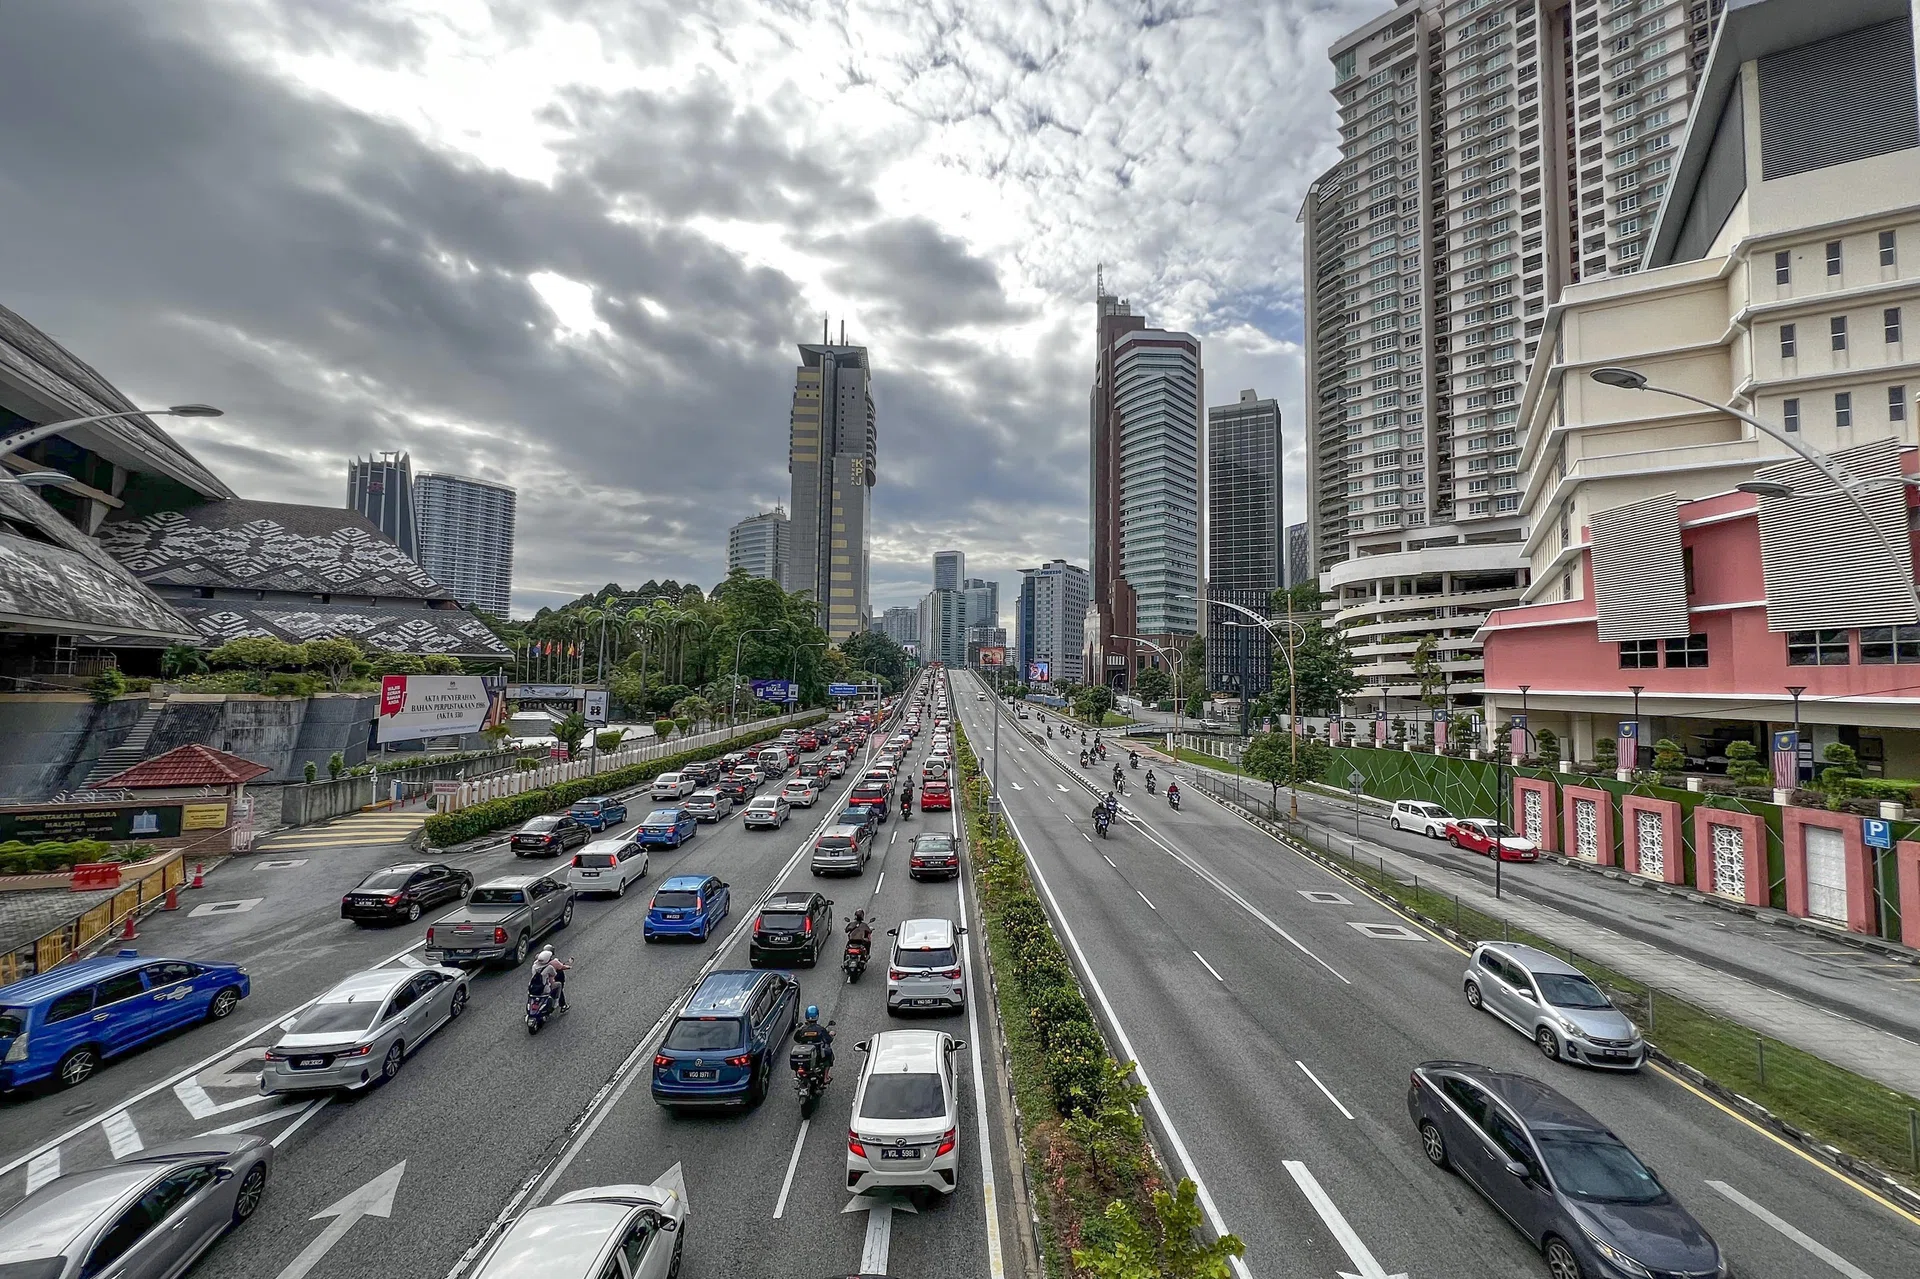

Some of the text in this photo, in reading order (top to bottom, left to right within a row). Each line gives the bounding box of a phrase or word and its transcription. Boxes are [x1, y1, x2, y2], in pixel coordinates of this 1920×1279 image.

[855, 458, 863, 486] KPJ
[440, 694, 477, 702] PENYERAHAN
[411, 704, 433, 712] BAHAN
[433, 702, 475, 711] PERPUSTAKAAN
[15, 813, 81, 821] PERPUSTAKAAN
[1870, 821, 1884, 836] P
